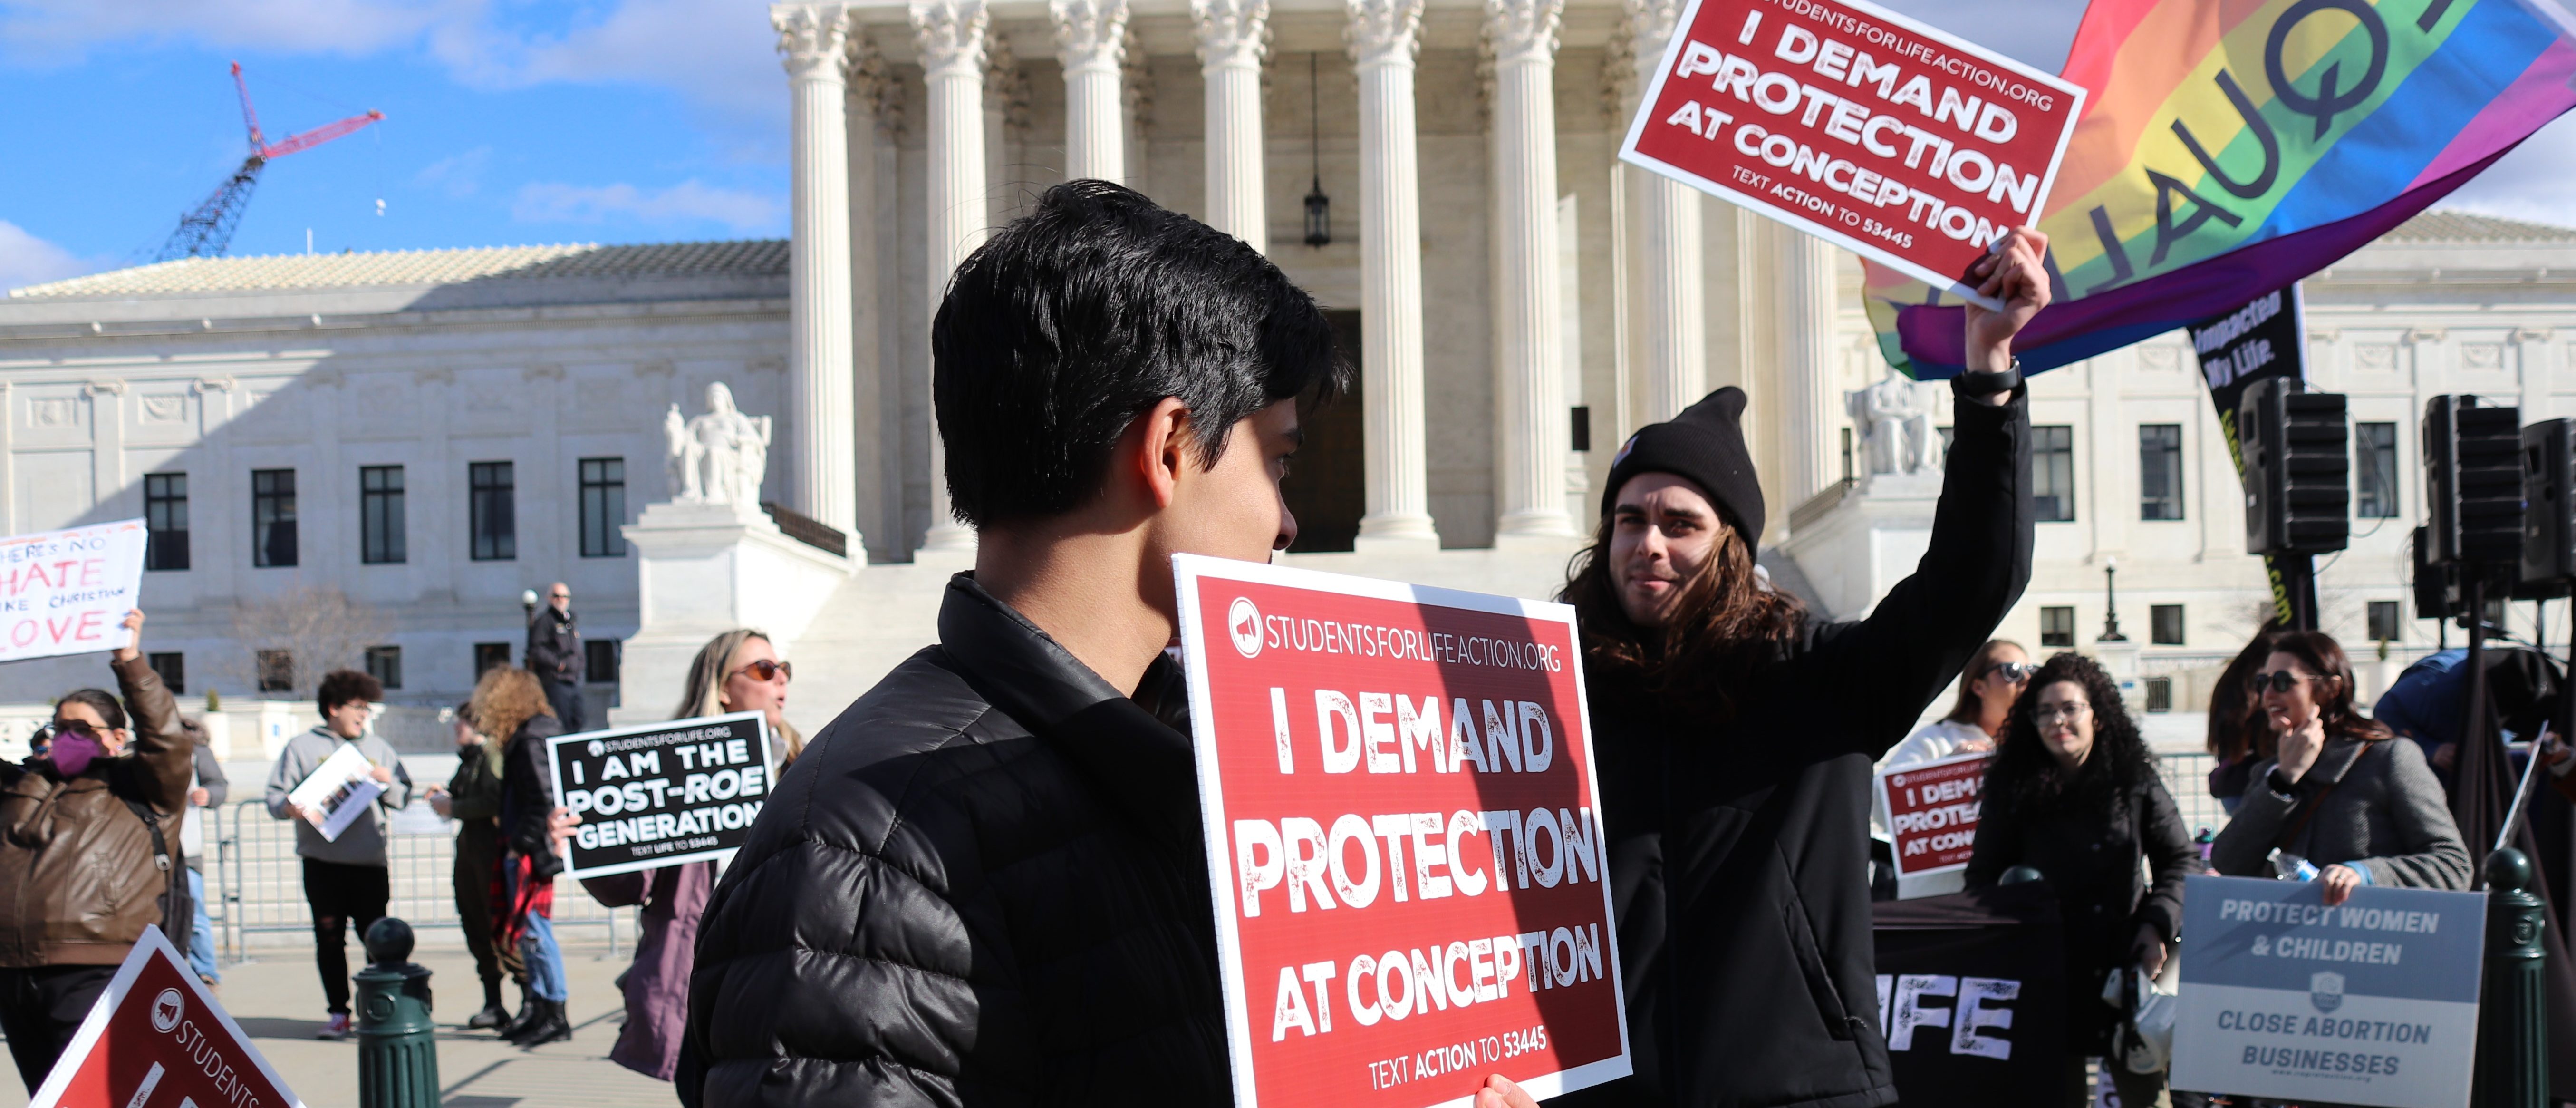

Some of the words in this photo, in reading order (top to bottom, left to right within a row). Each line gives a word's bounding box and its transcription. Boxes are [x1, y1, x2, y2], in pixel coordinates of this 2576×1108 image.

[1738, 10, 1763, 46] I
[1774, 22, 2017, 144] DEMAND
[1758, 0, 2054, 112] UDENTSFORLIFEACTION.ORG
[1676, 39, 2039, 214] PROTECTION
[1667, 100, 1734, 140] AT
[1733, 123, 2009, 253] CONCEPTION
[1732, 165, 1771, 190] TEXT
[1770, 182, 1834, 217] ACTION
[1838, 206, 1860, 227] TO
[1862, 217, 1913, 250] 53445
[2204, 356, 2233, 390] My
[70, 536, 106, 552] NO
[0, 558, 106, 597] HATE
[1265, 615, 1561, 672] STUDENTSFORLIFEACTION.ORG
[604, 726, 732, 753] STUDENTSFORLIFE.ORG
[1270, 687, 1294, 774] I
[1315, 689, 1553, 774] DEMAND
[571, 760, 585, 785] I
[601, 750, 661, 781] AM
[674, 739, 750, 770] THE
[565, 765, 765, 819] POST-ROE
[1905, 788, 1916, 807] I
[575, 800, 764, 850] GENERATION
[654, 842, 675, 854] LIFE
[675, 839, 689, 851] TO
[1904, 837, 1929, 857] AT
[1234, 807, 1598, 918] PROTECTION
[2219, 900, 2338, 927] PROTECT
[2340, 907, 2440, 934] WOMEN
[2251, 935, 2269, 957] &
[2276, 937, 2402, 965] CHILDREN
[1272, 960, 1336, 1041] AT
[1347, 923, 1602, 1026] CONCEPTION
[2217, 1011, 2298, 1034] CLOSE
[2304, 1017, 2432, 1044] ABORTION
[1369, 1056, 1409, 1090] TEXT
[1414, 1044, 1476, 1080] ACTION
[1477, 1037, 1500, 1062] TO
[1504, 1025, 1547, 1058] 53445
[2242, 1046, 2400, 1076] BUSINESSES
